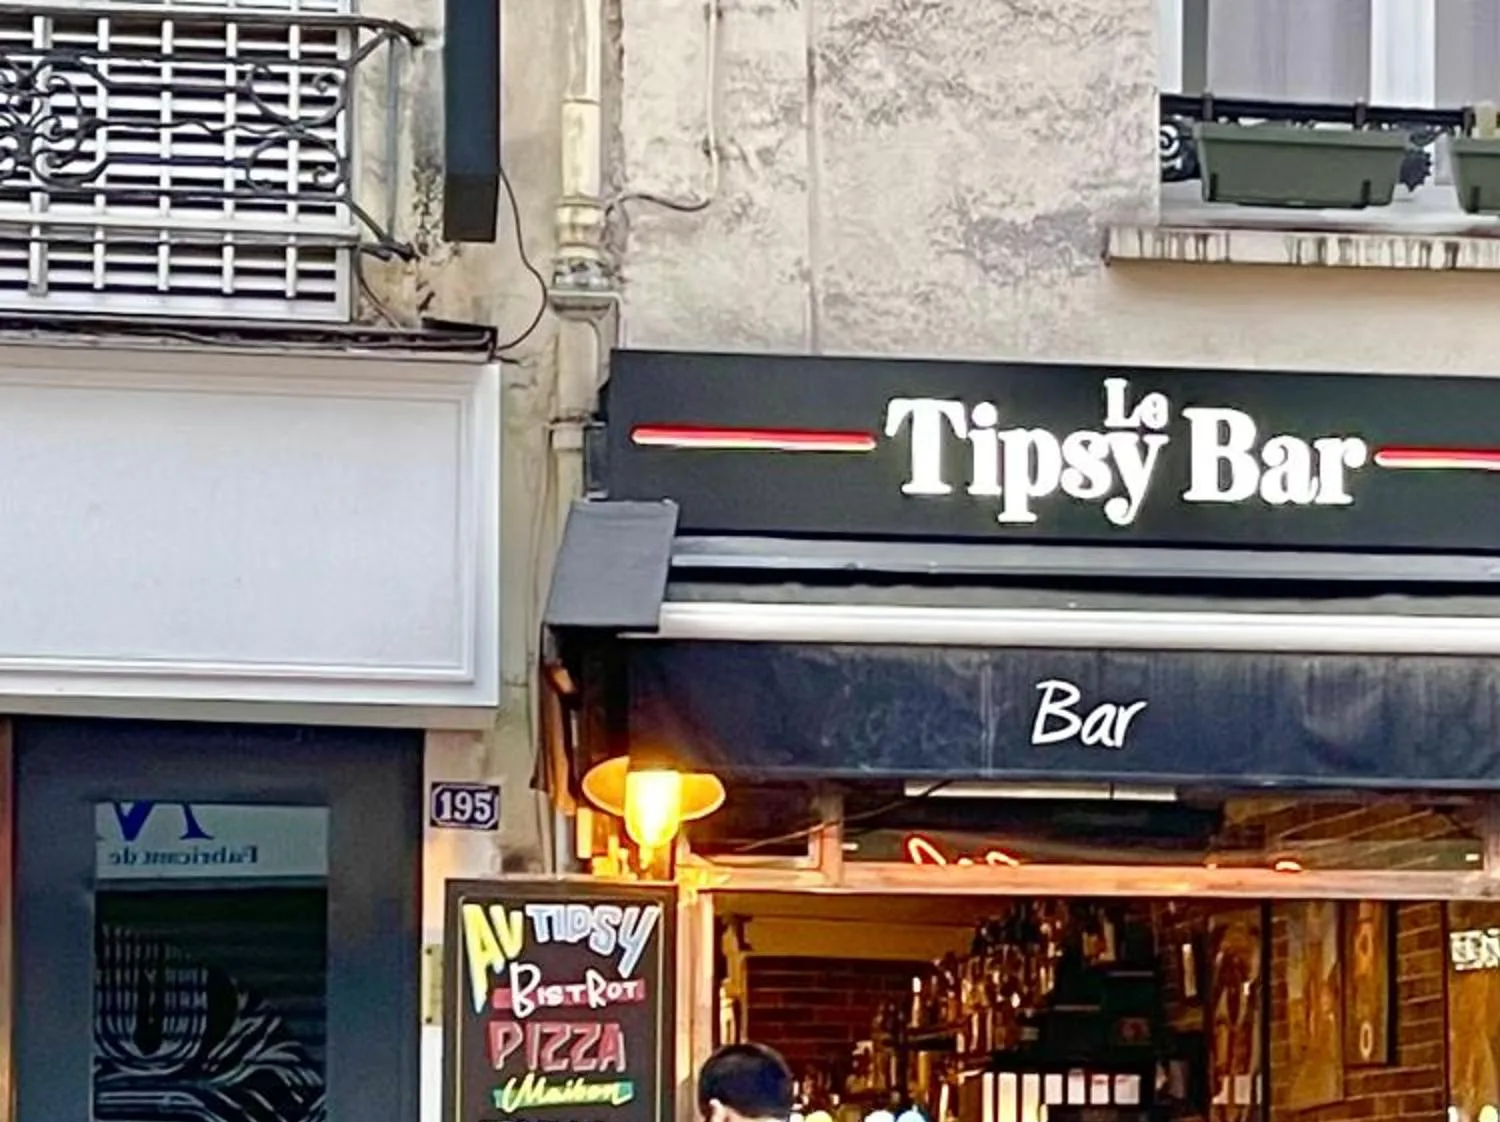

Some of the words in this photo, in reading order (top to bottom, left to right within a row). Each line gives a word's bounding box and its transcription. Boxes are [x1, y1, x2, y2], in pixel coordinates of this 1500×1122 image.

[1104, 377, 1169, 430] Le
[885, 398, 1169, 525] Tipsy
[1182, 407, 1367, 506] Bar
[1030, 678, 1147, 750] Bar
[440, 790, 492, 822] 195
[488, 1020, 627, 1073] PIZZA
